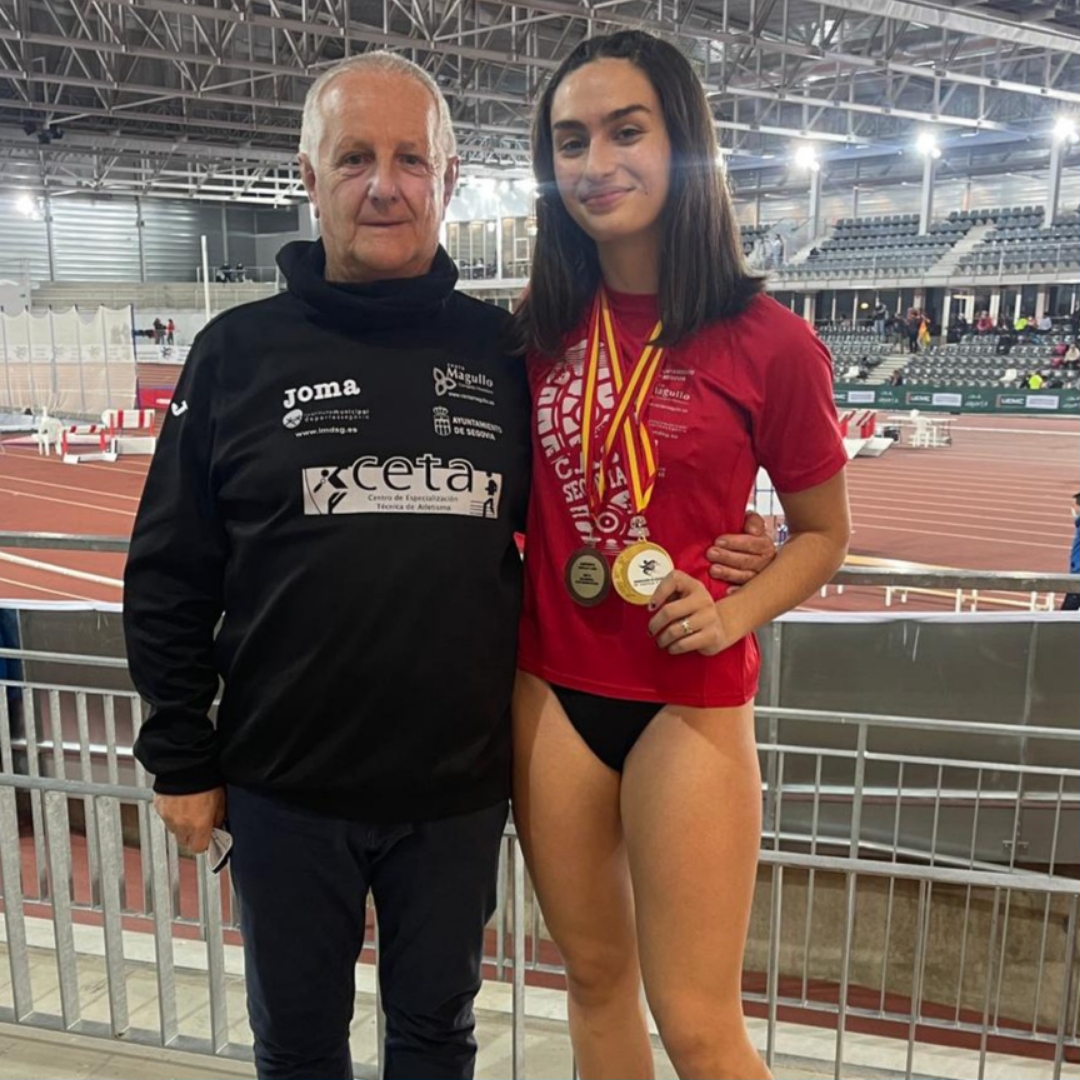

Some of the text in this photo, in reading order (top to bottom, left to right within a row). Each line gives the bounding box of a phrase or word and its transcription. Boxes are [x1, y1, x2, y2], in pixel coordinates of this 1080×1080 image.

[446, 367, 494, 387] Magullo
[454, 426, 465, 435] DE
[351, 453, 475, 493] ceta
